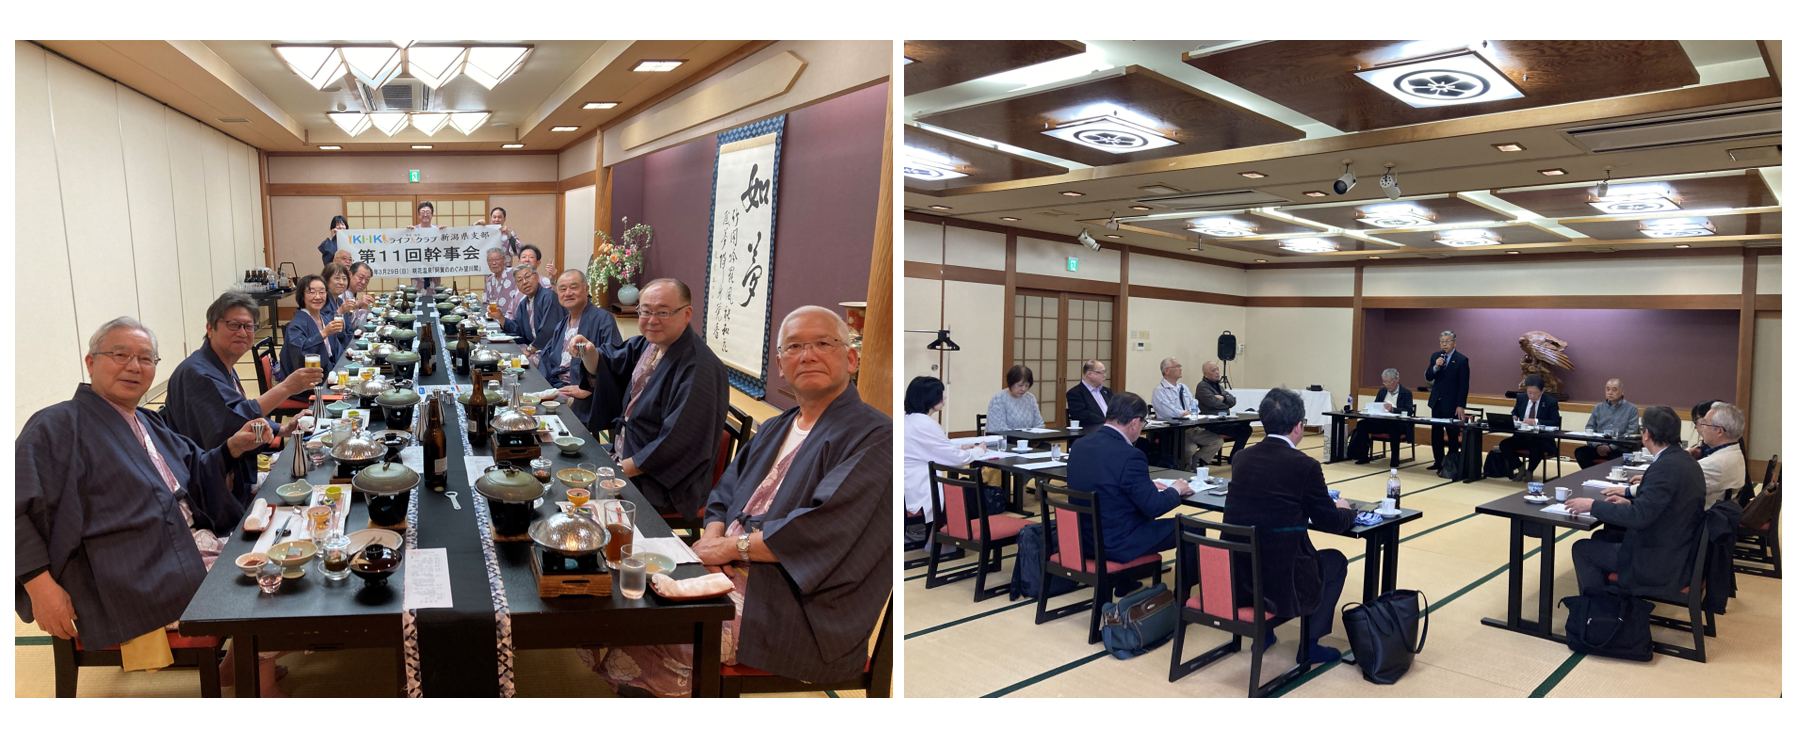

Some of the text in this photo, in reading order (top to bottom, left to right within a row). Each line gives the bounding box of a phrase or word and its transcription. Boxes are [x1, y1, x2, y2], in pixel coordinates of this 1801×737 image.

[440, 231, 490, 242] 新潟県支部
[358, 245, 480, 264] 第11回幹事会
